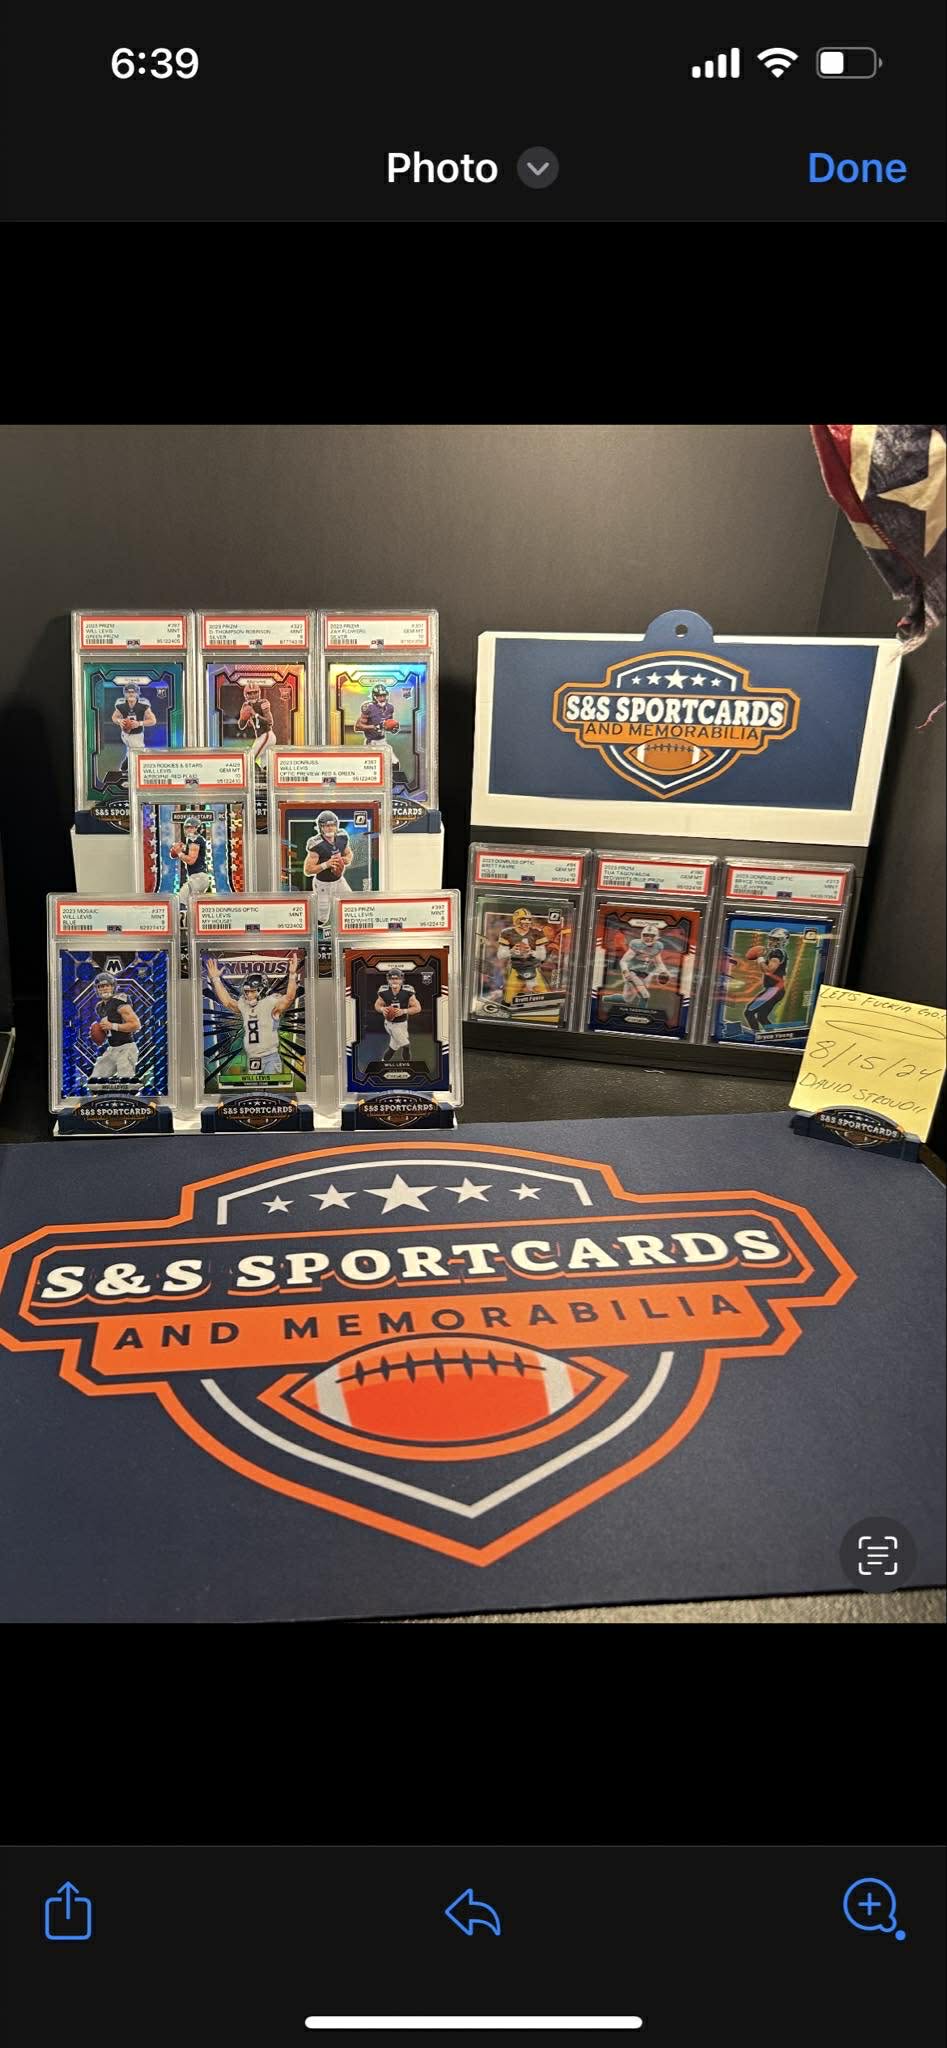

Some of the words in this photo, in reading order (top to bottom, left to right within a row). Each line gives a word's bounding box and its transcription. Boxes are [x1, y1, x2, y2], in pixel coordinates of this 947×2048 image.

[110, 48, 200, 80] 6:39
[387, 151, 498, 184] Photo
[808, 151, 907, 184] Done
[566, 696, 610, 722] S&S
[615, 698, 784, 728] SPORTCARDS
[584, 724, 623, 736] AND
[628, 724, 760, 741] MEMORABILIA
[810, 1040, 942, 1080] 8/15/24
[799, 1072, 852, 1094] DAVID
[96, 1108, 152, 1116] SPORTCARDS
[239, 1106, 293, 1114] SPORTCARDS
[380, 1104, 434, 1112] SPORTCARDS
[820, 1114, 836, 1124] S&S
[837, 1118, 898, 1138] SPORTCARDS
[41, 1259, 203, 1298] S&S
[236, 1230, 780, 1288] SPORTCARDS
[113, 1321, 241, 1350] AND
[284, 1294, 741, 1340] MEMORABILIA
